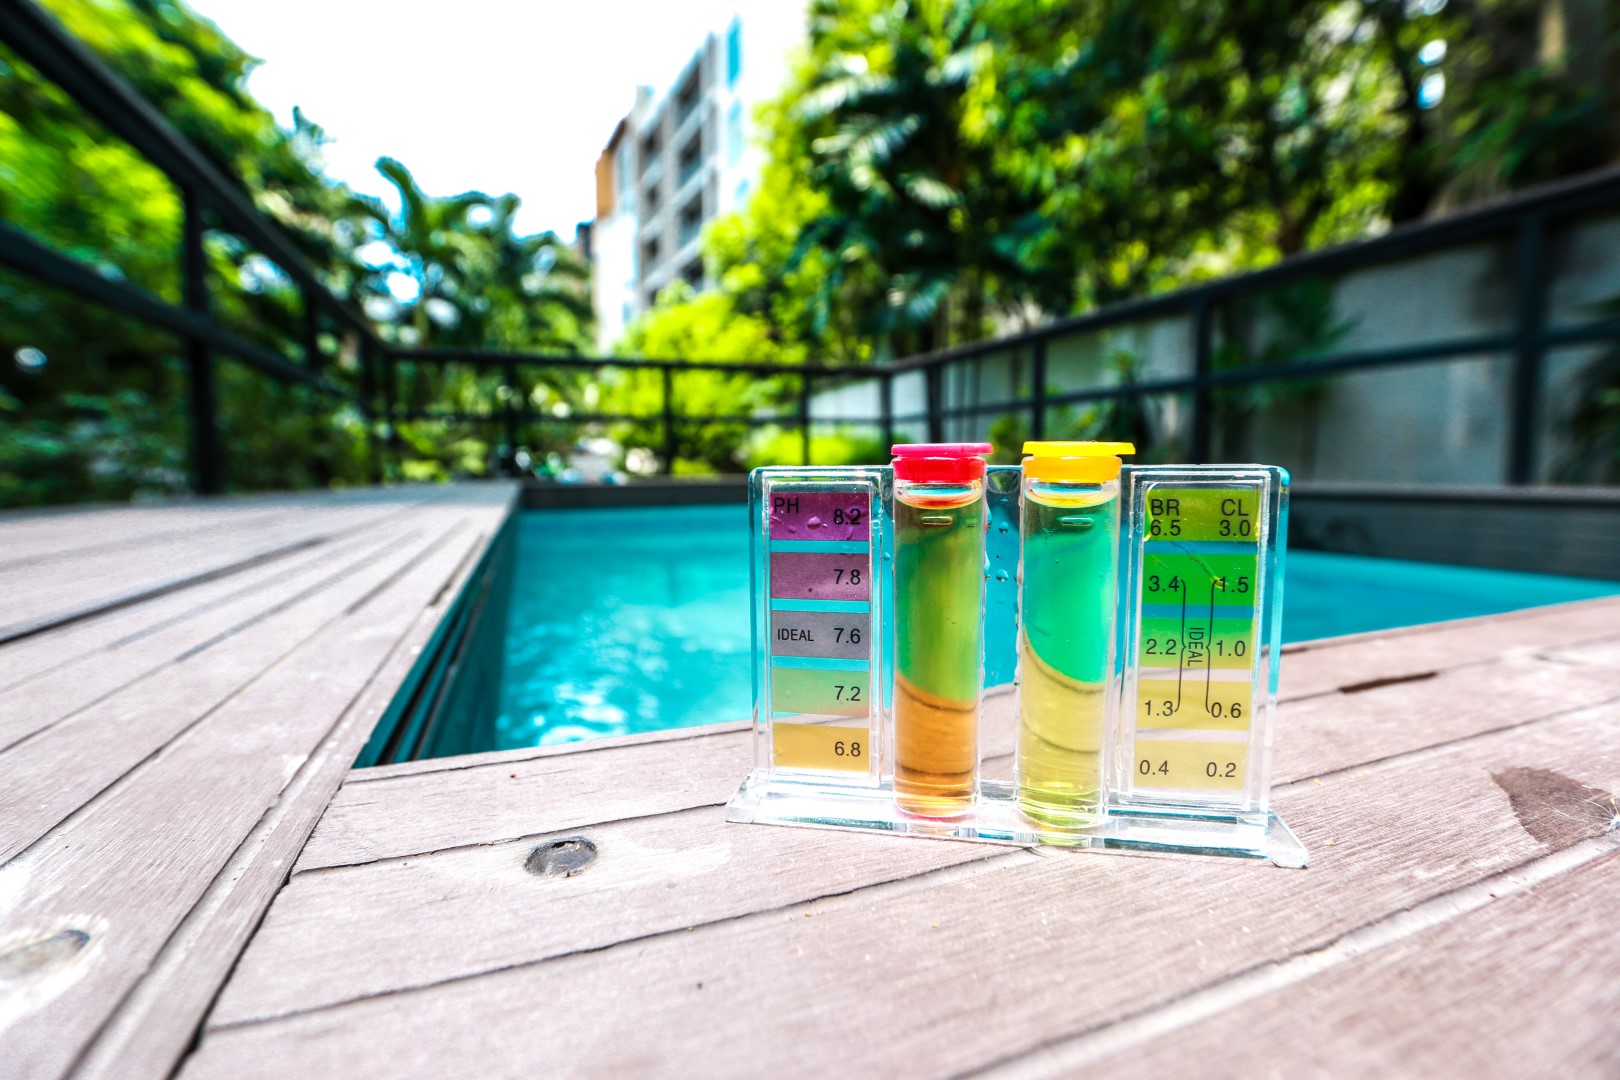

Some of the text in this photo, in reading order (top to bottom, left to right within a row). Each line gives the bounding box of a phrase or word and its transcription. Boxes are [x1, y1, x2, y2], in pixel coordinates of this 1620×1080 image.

[774, 498, 799, 513] PH
[1151, 498, 1249, 516] BR CL
[833, 508, 861, 525] 8.2
[1150, 519, 1250, 536] 6.5 3.0
[833, 569, 861, 585] 7.8
[1148, 576, 1248, 593] 3.4 1.5
[777, 628, 861, 644] IDEAL 7.6
[1146, 639, 1176, 655] 2.2
[1188, 628, 1204, 667] IDEAL
[1216, 640, 1246, 656] 1.0
[834, 686, 861, 702] 7.2
[1144, 700, 1242, 718] 1.3 0.6
[834, 741, 861, 757] 6.8
[1139, 760, 1236, 778] 0.4 0.2
